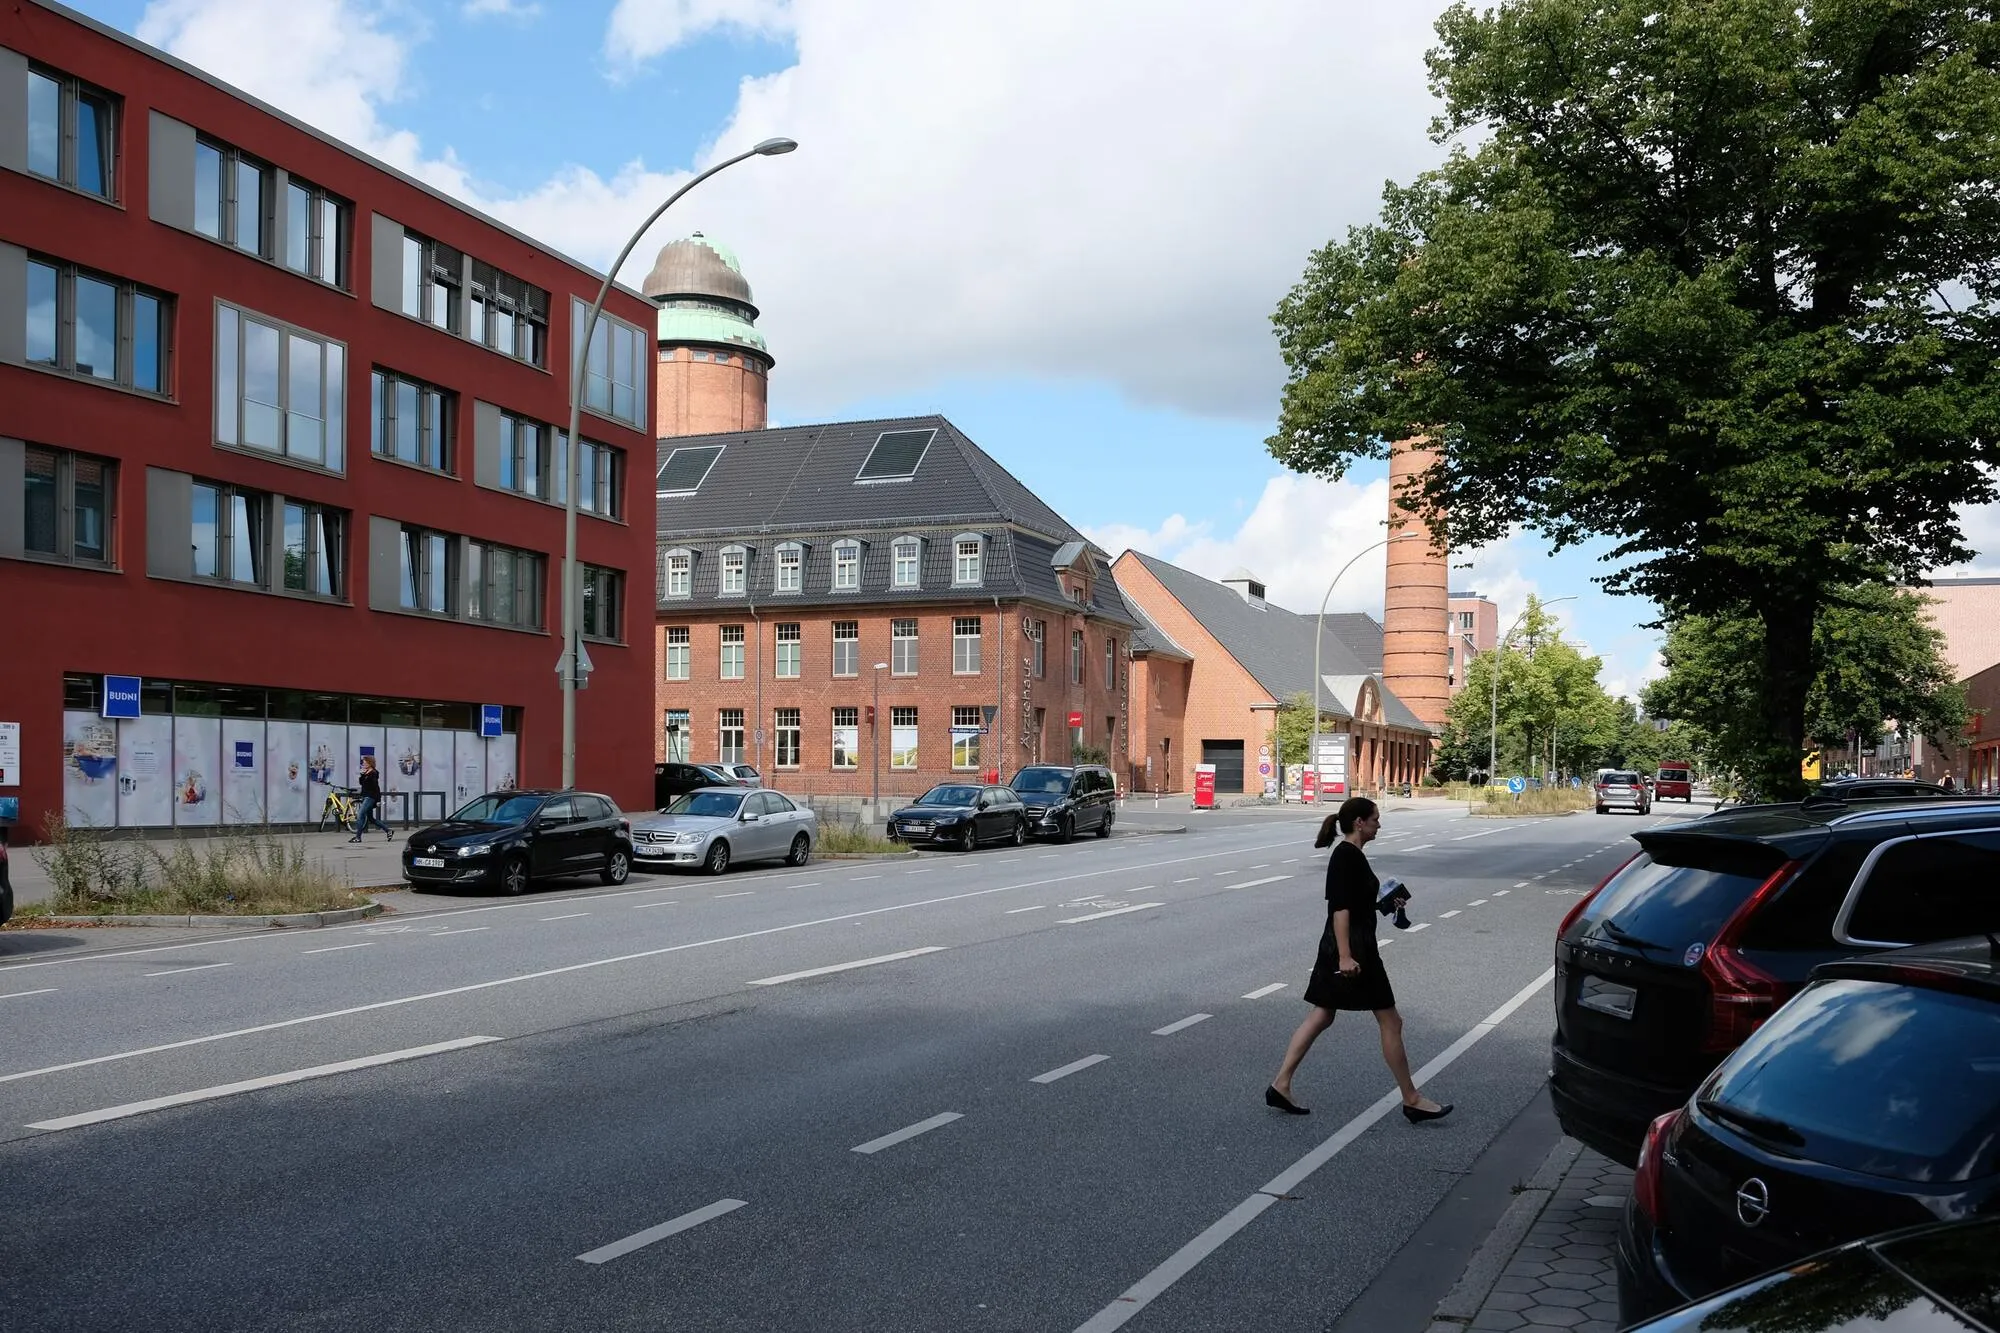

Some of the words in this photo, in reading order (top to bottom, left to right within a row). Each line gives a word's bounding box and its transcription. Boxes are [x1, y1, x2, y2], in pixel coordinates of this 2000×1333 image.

[109, 691, 137, 701] BUDNI
[1020, 657, 1031, 749] Ärztehaus
[485, 716, 501, 724] BUDNI
[1572, 947, 1633, 968] VOLVO
